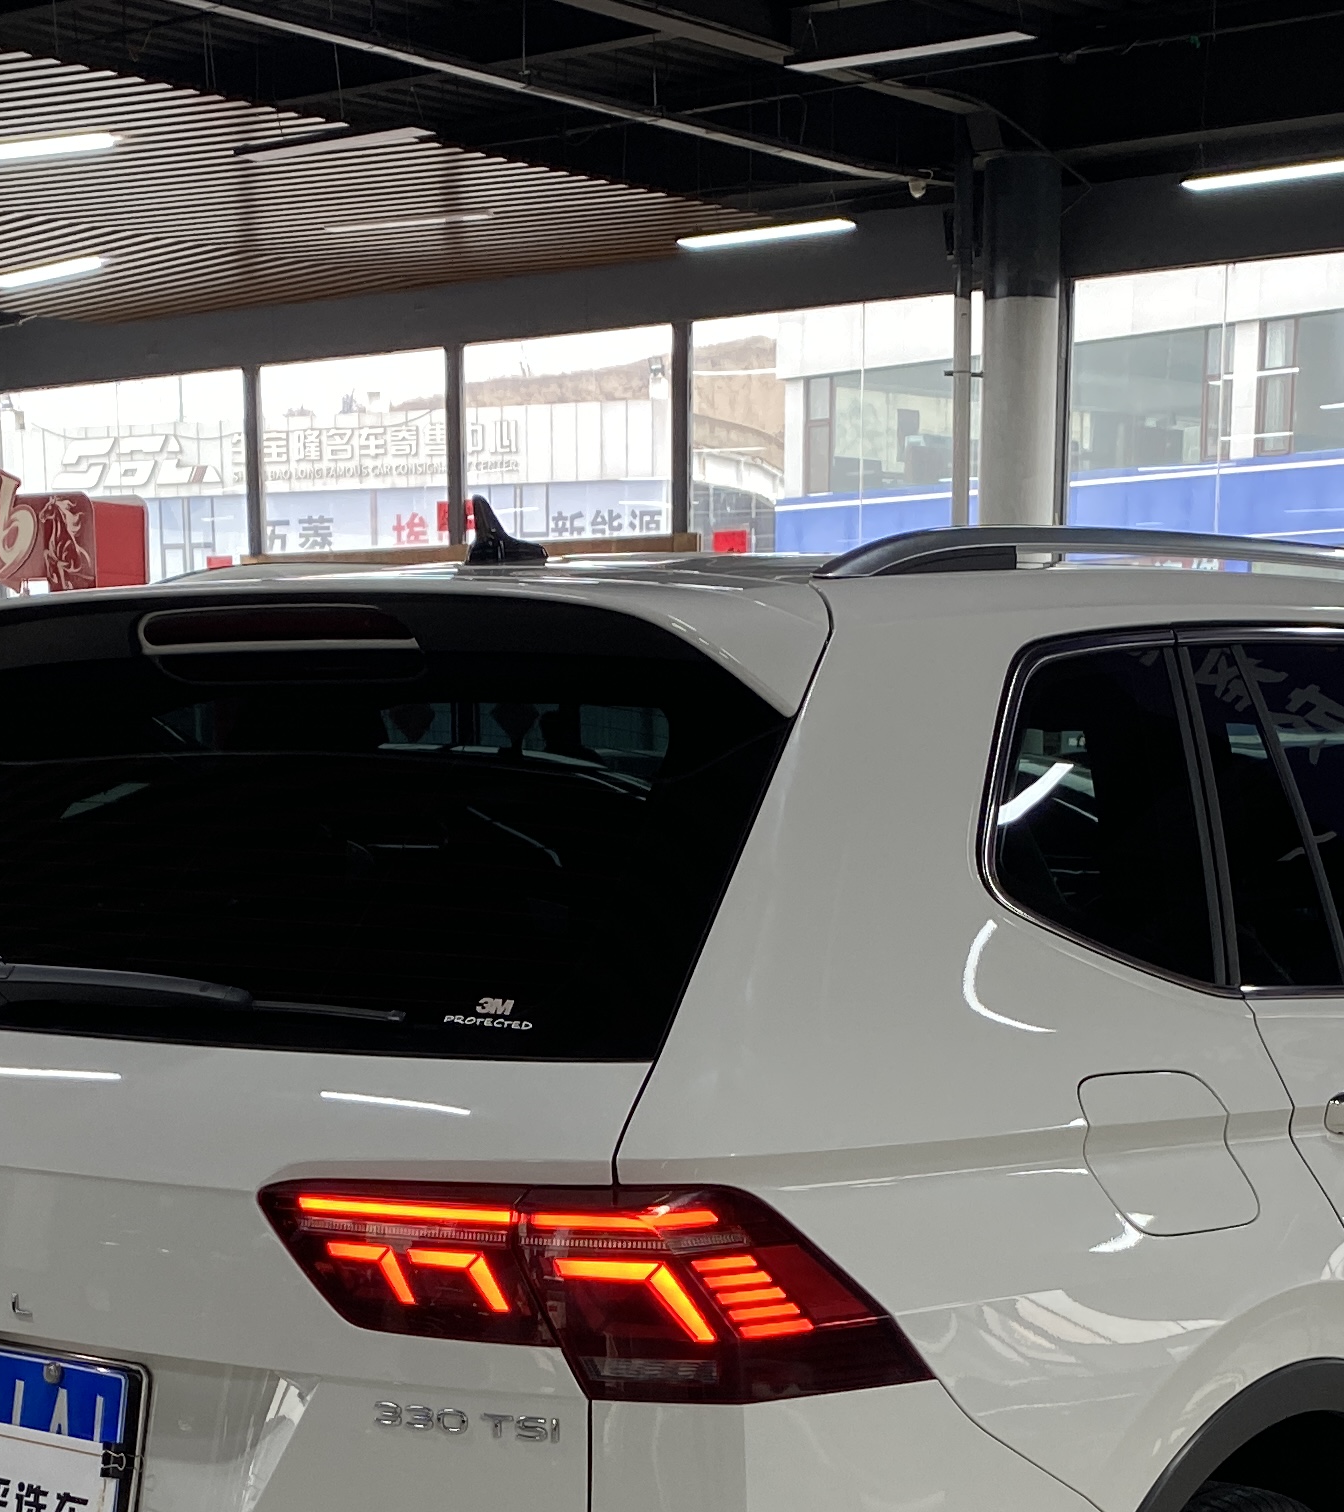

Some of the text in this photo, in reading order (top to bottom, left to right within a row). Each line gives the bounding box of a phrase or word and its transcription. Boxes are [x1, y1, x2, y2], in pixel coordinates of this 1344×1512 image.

[325, 464, 369, 478] FAMOUS
[370, 462, 392, 476] CAR
[475, 997, 515, 1016] 3M
[443, 1014, 533, 1031] PROTECTED
[11, 1293, 34, 1319] L
[374, 1400, 561, 1444] 330 TSI
